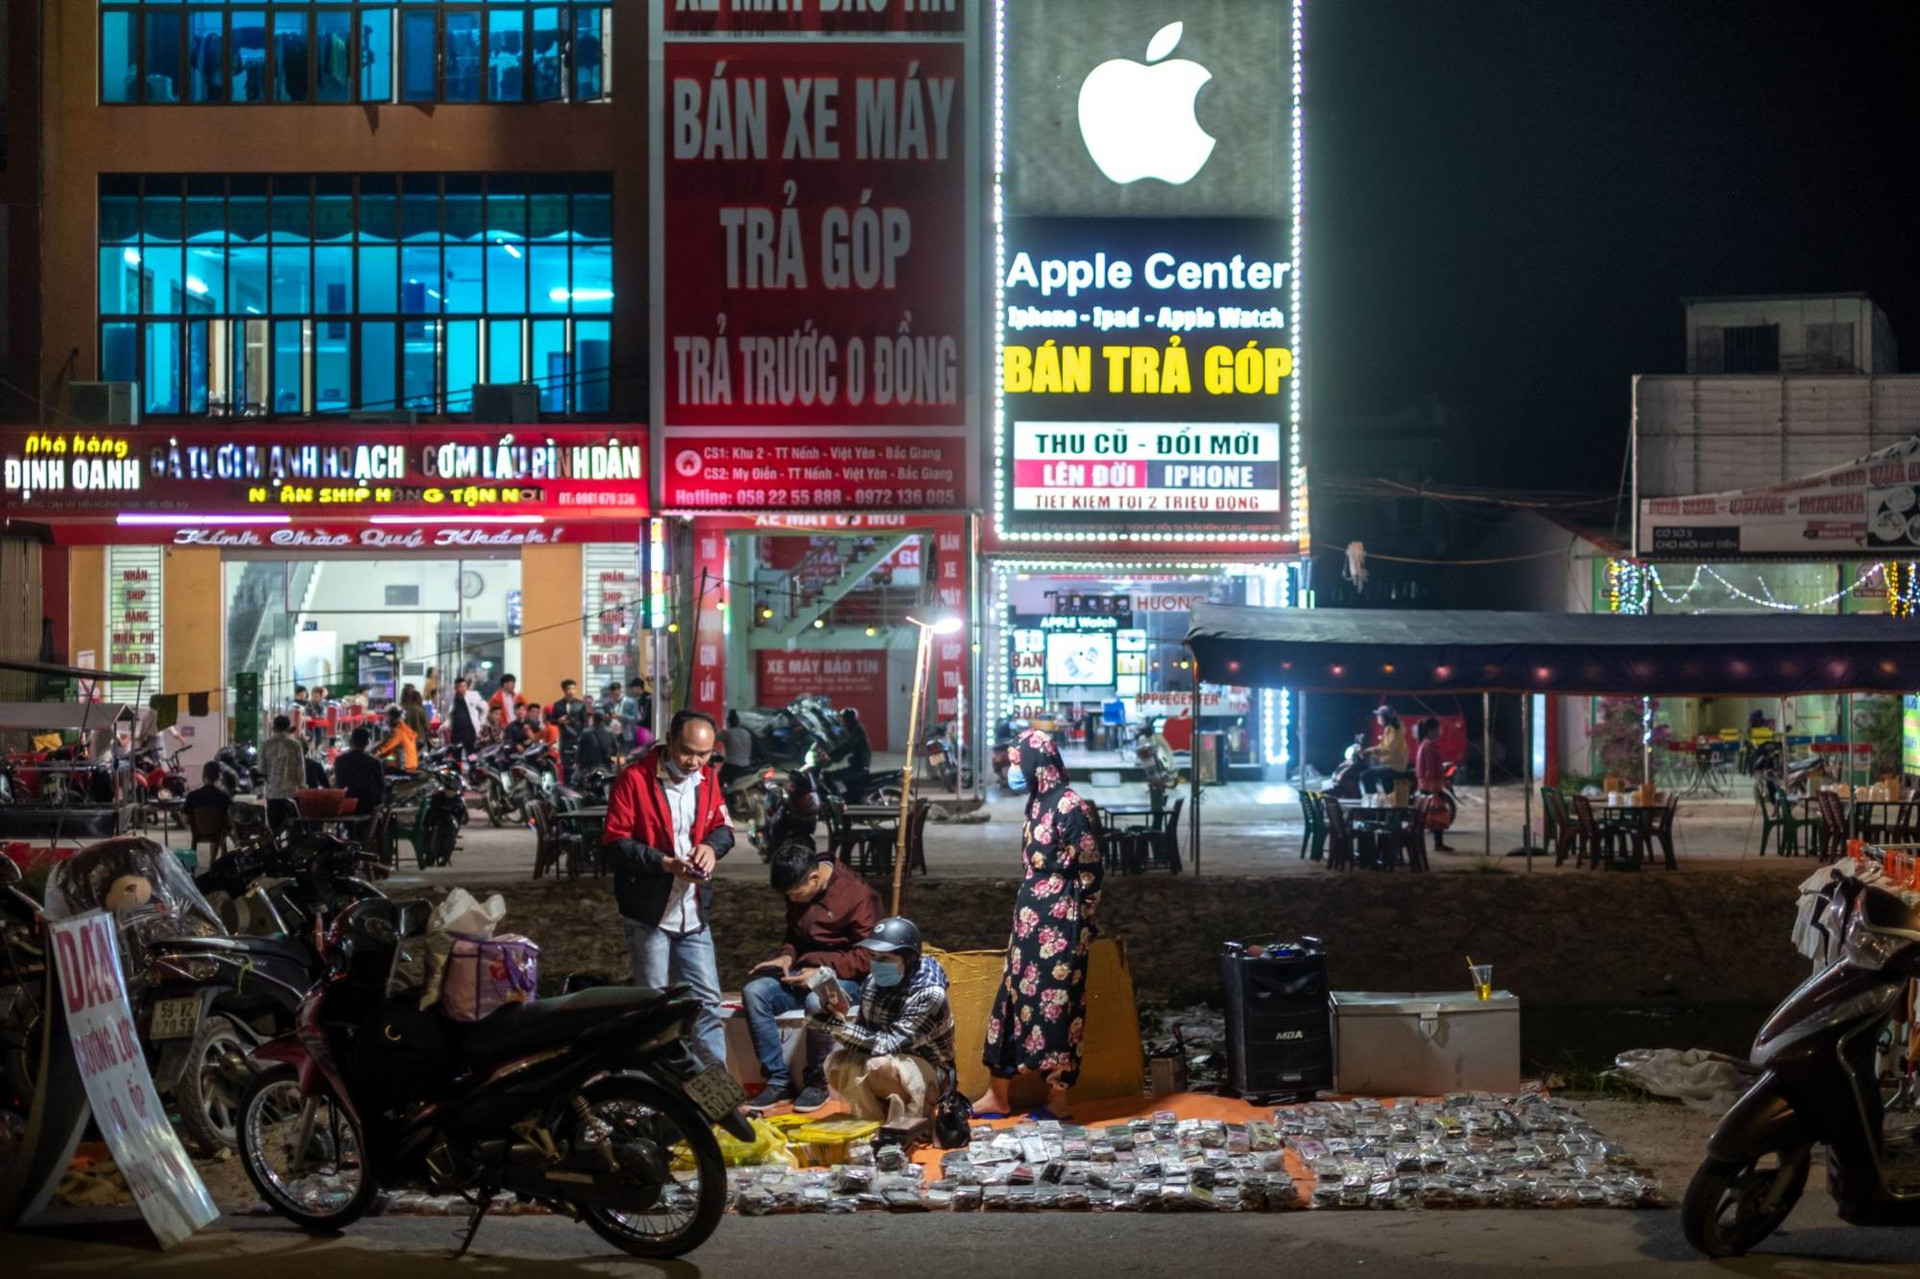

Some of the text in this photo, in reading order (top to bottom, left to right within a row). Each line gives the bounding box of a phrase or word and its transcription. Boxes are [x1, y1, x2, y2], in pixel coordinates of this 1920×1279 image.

[673, 60, 955, 160] BÁN XE MÁY
[719, 179, 911, 290] TRẢ GÓP
[1005, 252, 1292, 297] Apple Center
[1007, 306, 1077, 331] Iphone
[1093, 307, 1140, 331] Ipad
[1157, 307, 1215, 331] Apple
[1218, 307, 1285, 329] Watch
[674, 312, 733, 406] TRẢ
[740, 319, 837, 406] TRƯỚC
[874, 310, 957, 406] ĐỒNG
[1003, 335, 1293, 395] BÁN TRẢ GÓP
[703, 446, 730, 460] CS1:
[732, 446, 754, 460] Khu
[756, 446, 764, 460] 2
[774, 446, 789, 460] TT
[909, 446, 942, 462] Giang
[1034, 433, 1085, 454] THU
[1094, 428, 1128, 454] CŨ
[591, 438, 642, 479] DÂN
[5, 459, 140, 500] ĐỊNH OANH
[703, 467, 730, 480] CS2:
[788, 467, 802, 480] TT
[921, 467, 953, 482] Giang
[1043, 461, 1254, 488] LÊN ĐỜI IPHONE
[319, 486, 370, 503] SHIP
[676, 488, 733, 505] Hotline:
[768, 489, 787, 505] 22
[790, 489, 810, 505] 55
[1148, 495, 1158, 509] 2
[173, 529, 262, 546] Kính
[270, 529, 352, 546] Chào
[359, 529, 425, 548] Quý
[767, 658, 785, 674] XE
[788, 656, 820, 674] MÁY
